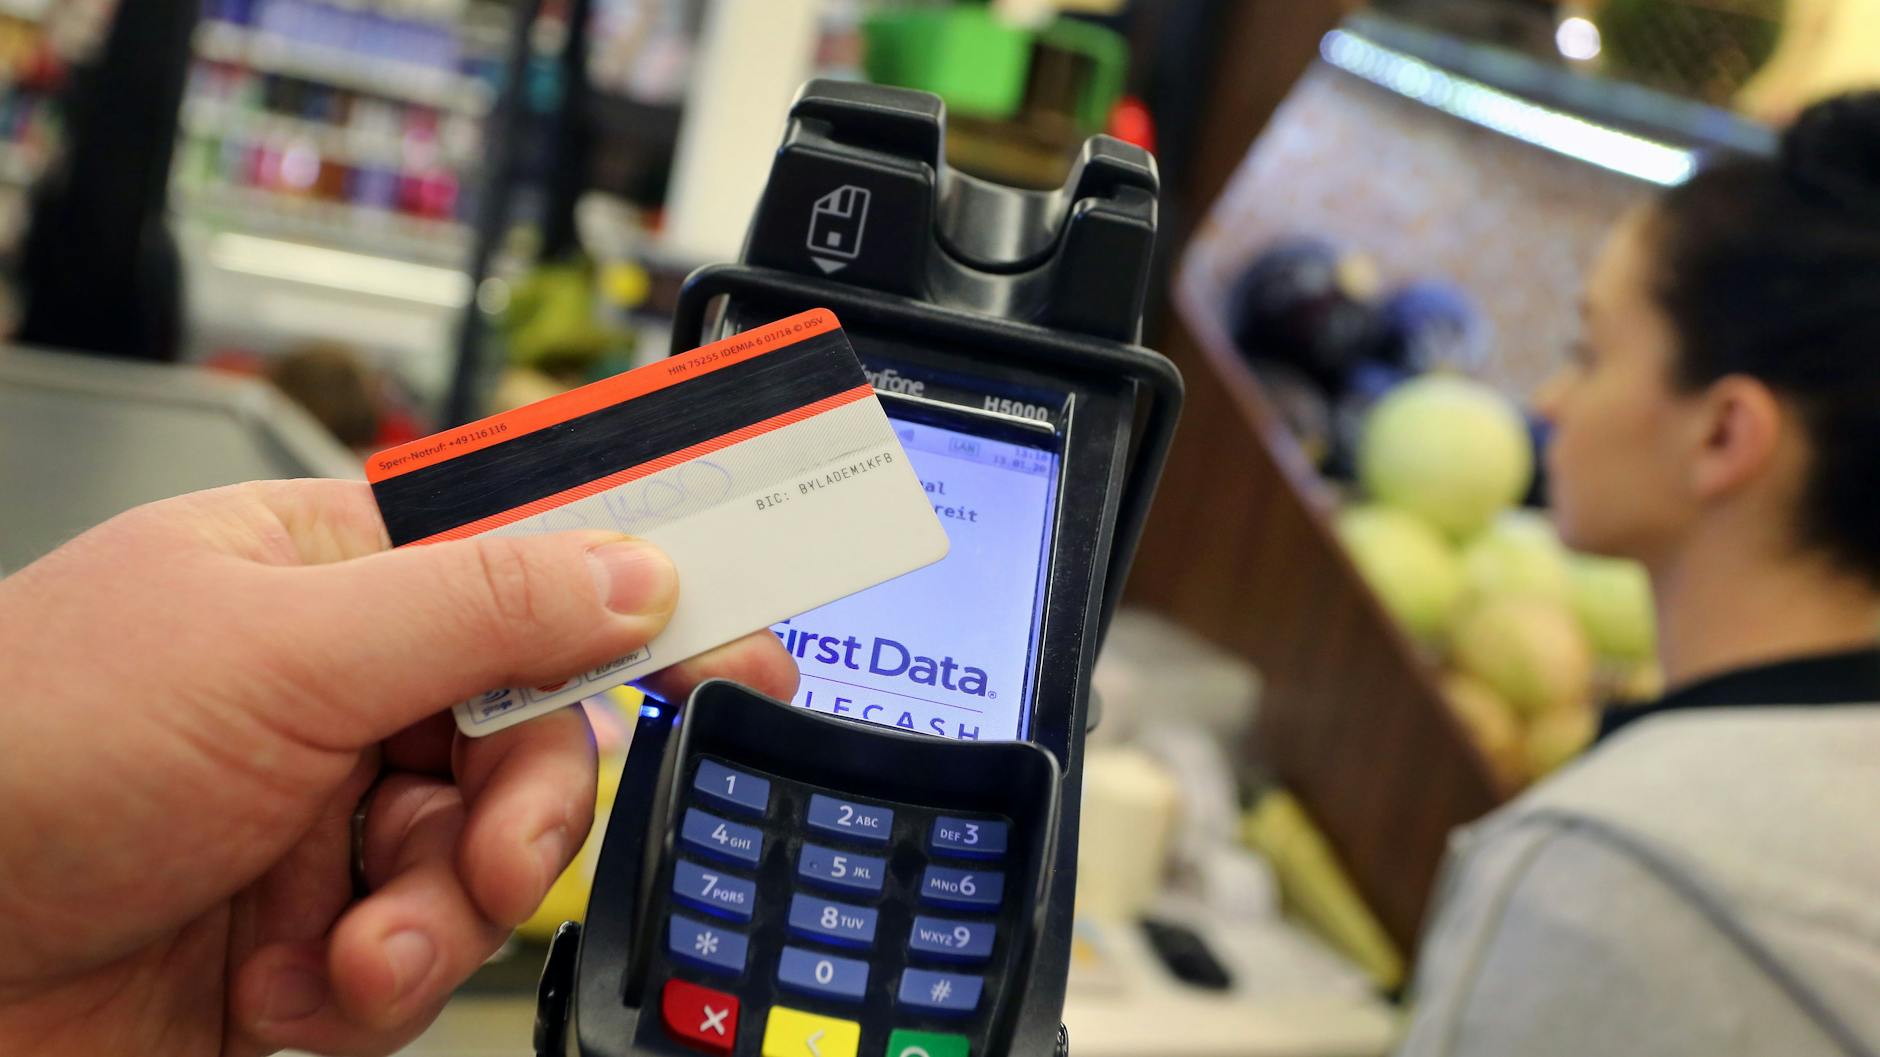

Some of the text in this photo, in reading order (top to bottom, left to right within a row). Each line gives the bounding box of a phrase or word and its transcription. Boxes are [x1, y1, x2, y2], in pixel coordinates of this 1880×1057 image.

[688, 352, 719, 370] 75255
[720, 340, 755, 359] IDEMIA
[764, 327, 792, 344] 01/18
[805, 316, 824, 330] DSV
[983, 395, 1048, 422] H5000
[378, 443, 447, 471] Sperr-Notruf:
[755, 492, 790, 511] BIC:
[798, 452, 893, 495] BYLADEM1KFB
[934, 504, 979, 524] reit
[725, 775, 737, 795] 1
[837, 805, 878, 828] 2 ABC
[711, 823, 751, 850] 4 GHI
[940, 823, 979, 845] DEF 3
[831, 856, 871, 880] 5 JKL
[701, 874, 745, 905] 7 PQRS
[930, 875, 976, 896] MNO 6
[820, 907, 864, 930] 8 TUV
[919, 926, 970, 948] WXYZ 9
[815, 960, 833, 984] 0
